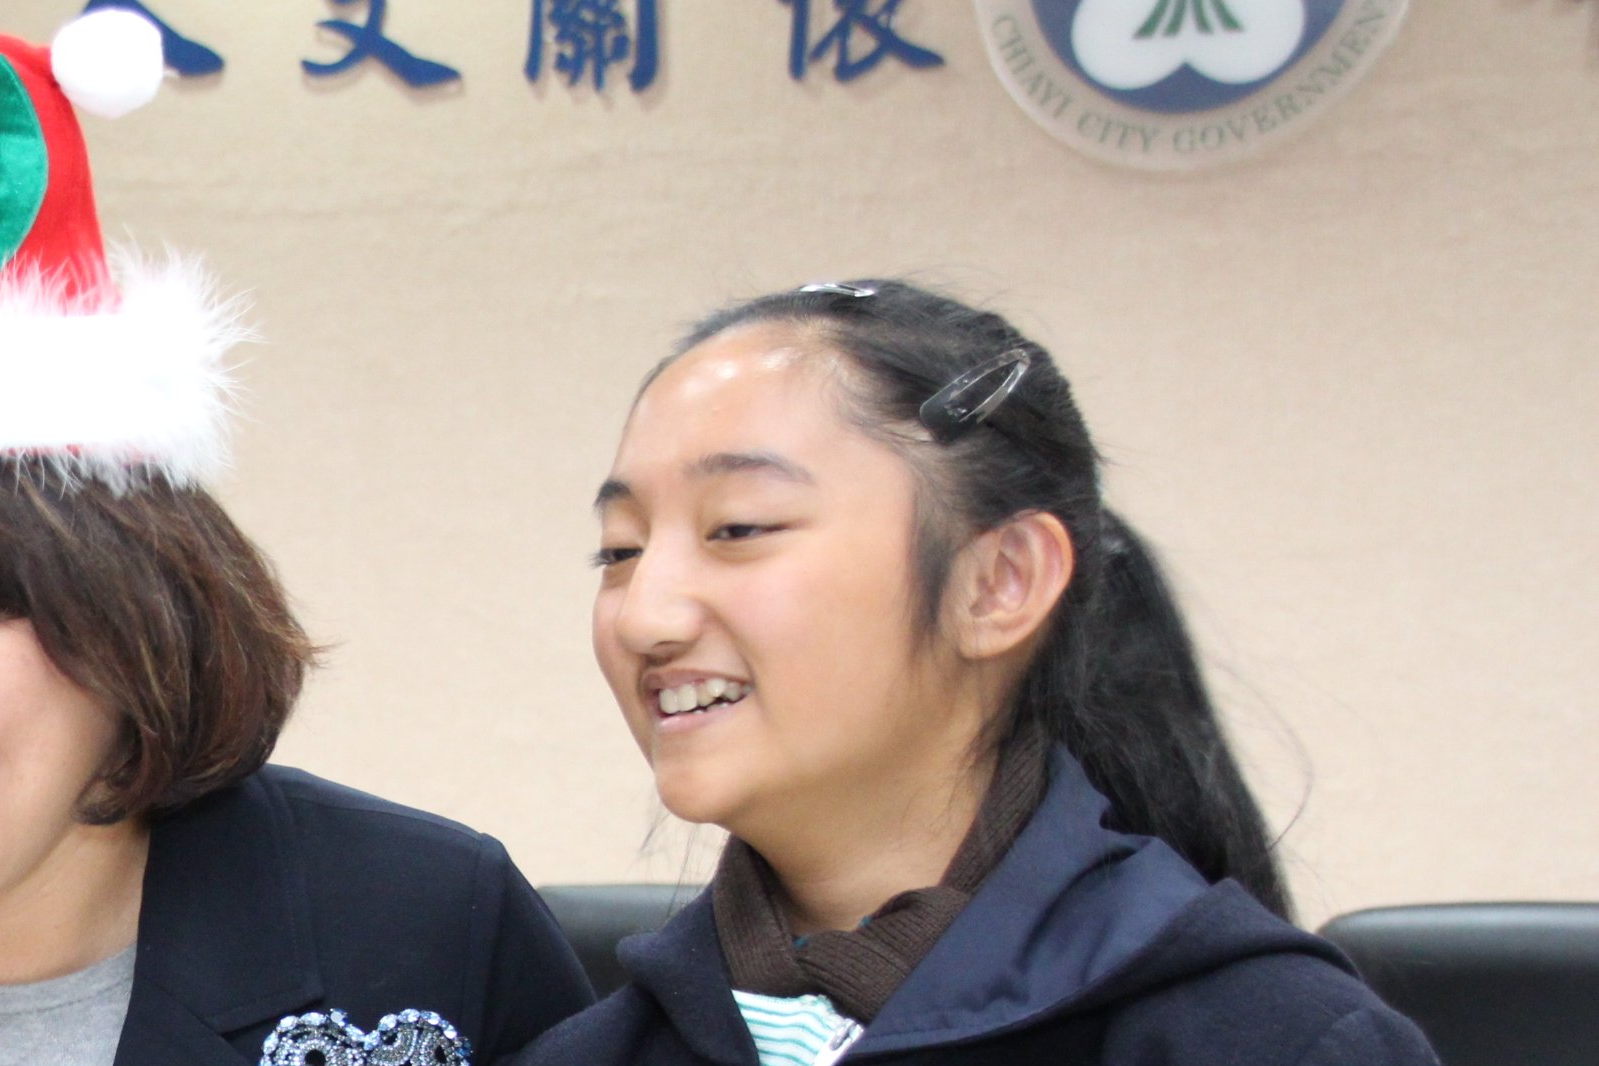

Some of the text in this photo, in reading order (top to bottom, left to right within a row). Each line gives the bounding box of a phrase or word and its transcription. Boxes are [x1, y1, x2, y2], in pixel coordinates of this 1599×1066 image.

[81, 0, 945, 93] 文關懷
[990, 0, 1394, 155] CHIAYI CITY GOVERNMEN
